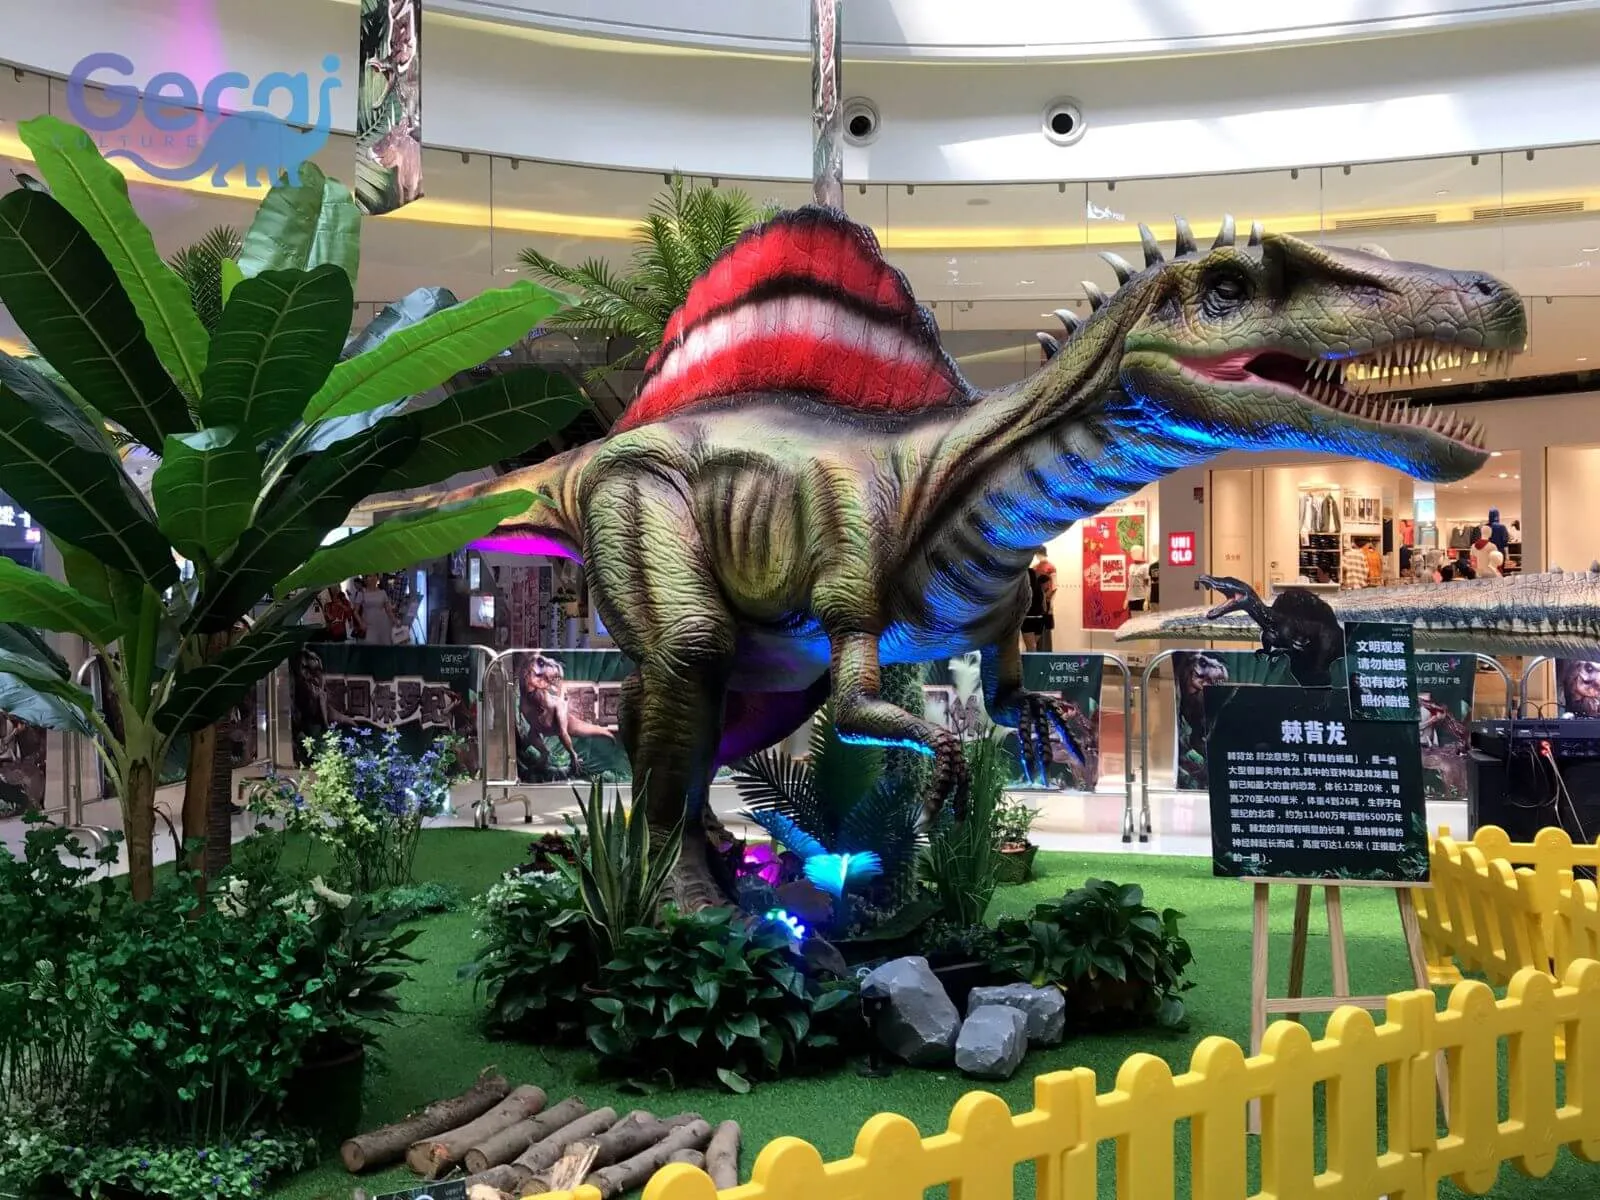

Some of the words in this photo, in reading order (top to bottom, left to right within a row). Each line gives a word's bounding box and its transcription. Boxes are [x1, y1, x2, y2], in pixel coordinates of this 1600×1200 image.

[1170, 536, 1190, 548] UNI
[1170, 549, 1193, 564] QLO
[1356, 640, 1405, 653] 文明观赏
[1049, 661, 1080, 671] vanke
[1357, 658, 1407, 671] 请勿触摸
[1416, 661, 1450, 672] vanke
[1359, 676, 1408, 689] 如有破坏
[1361, 694, 1410, 708] 照价赔偿
[1281, 720, 1348, 745] 棘背龙
